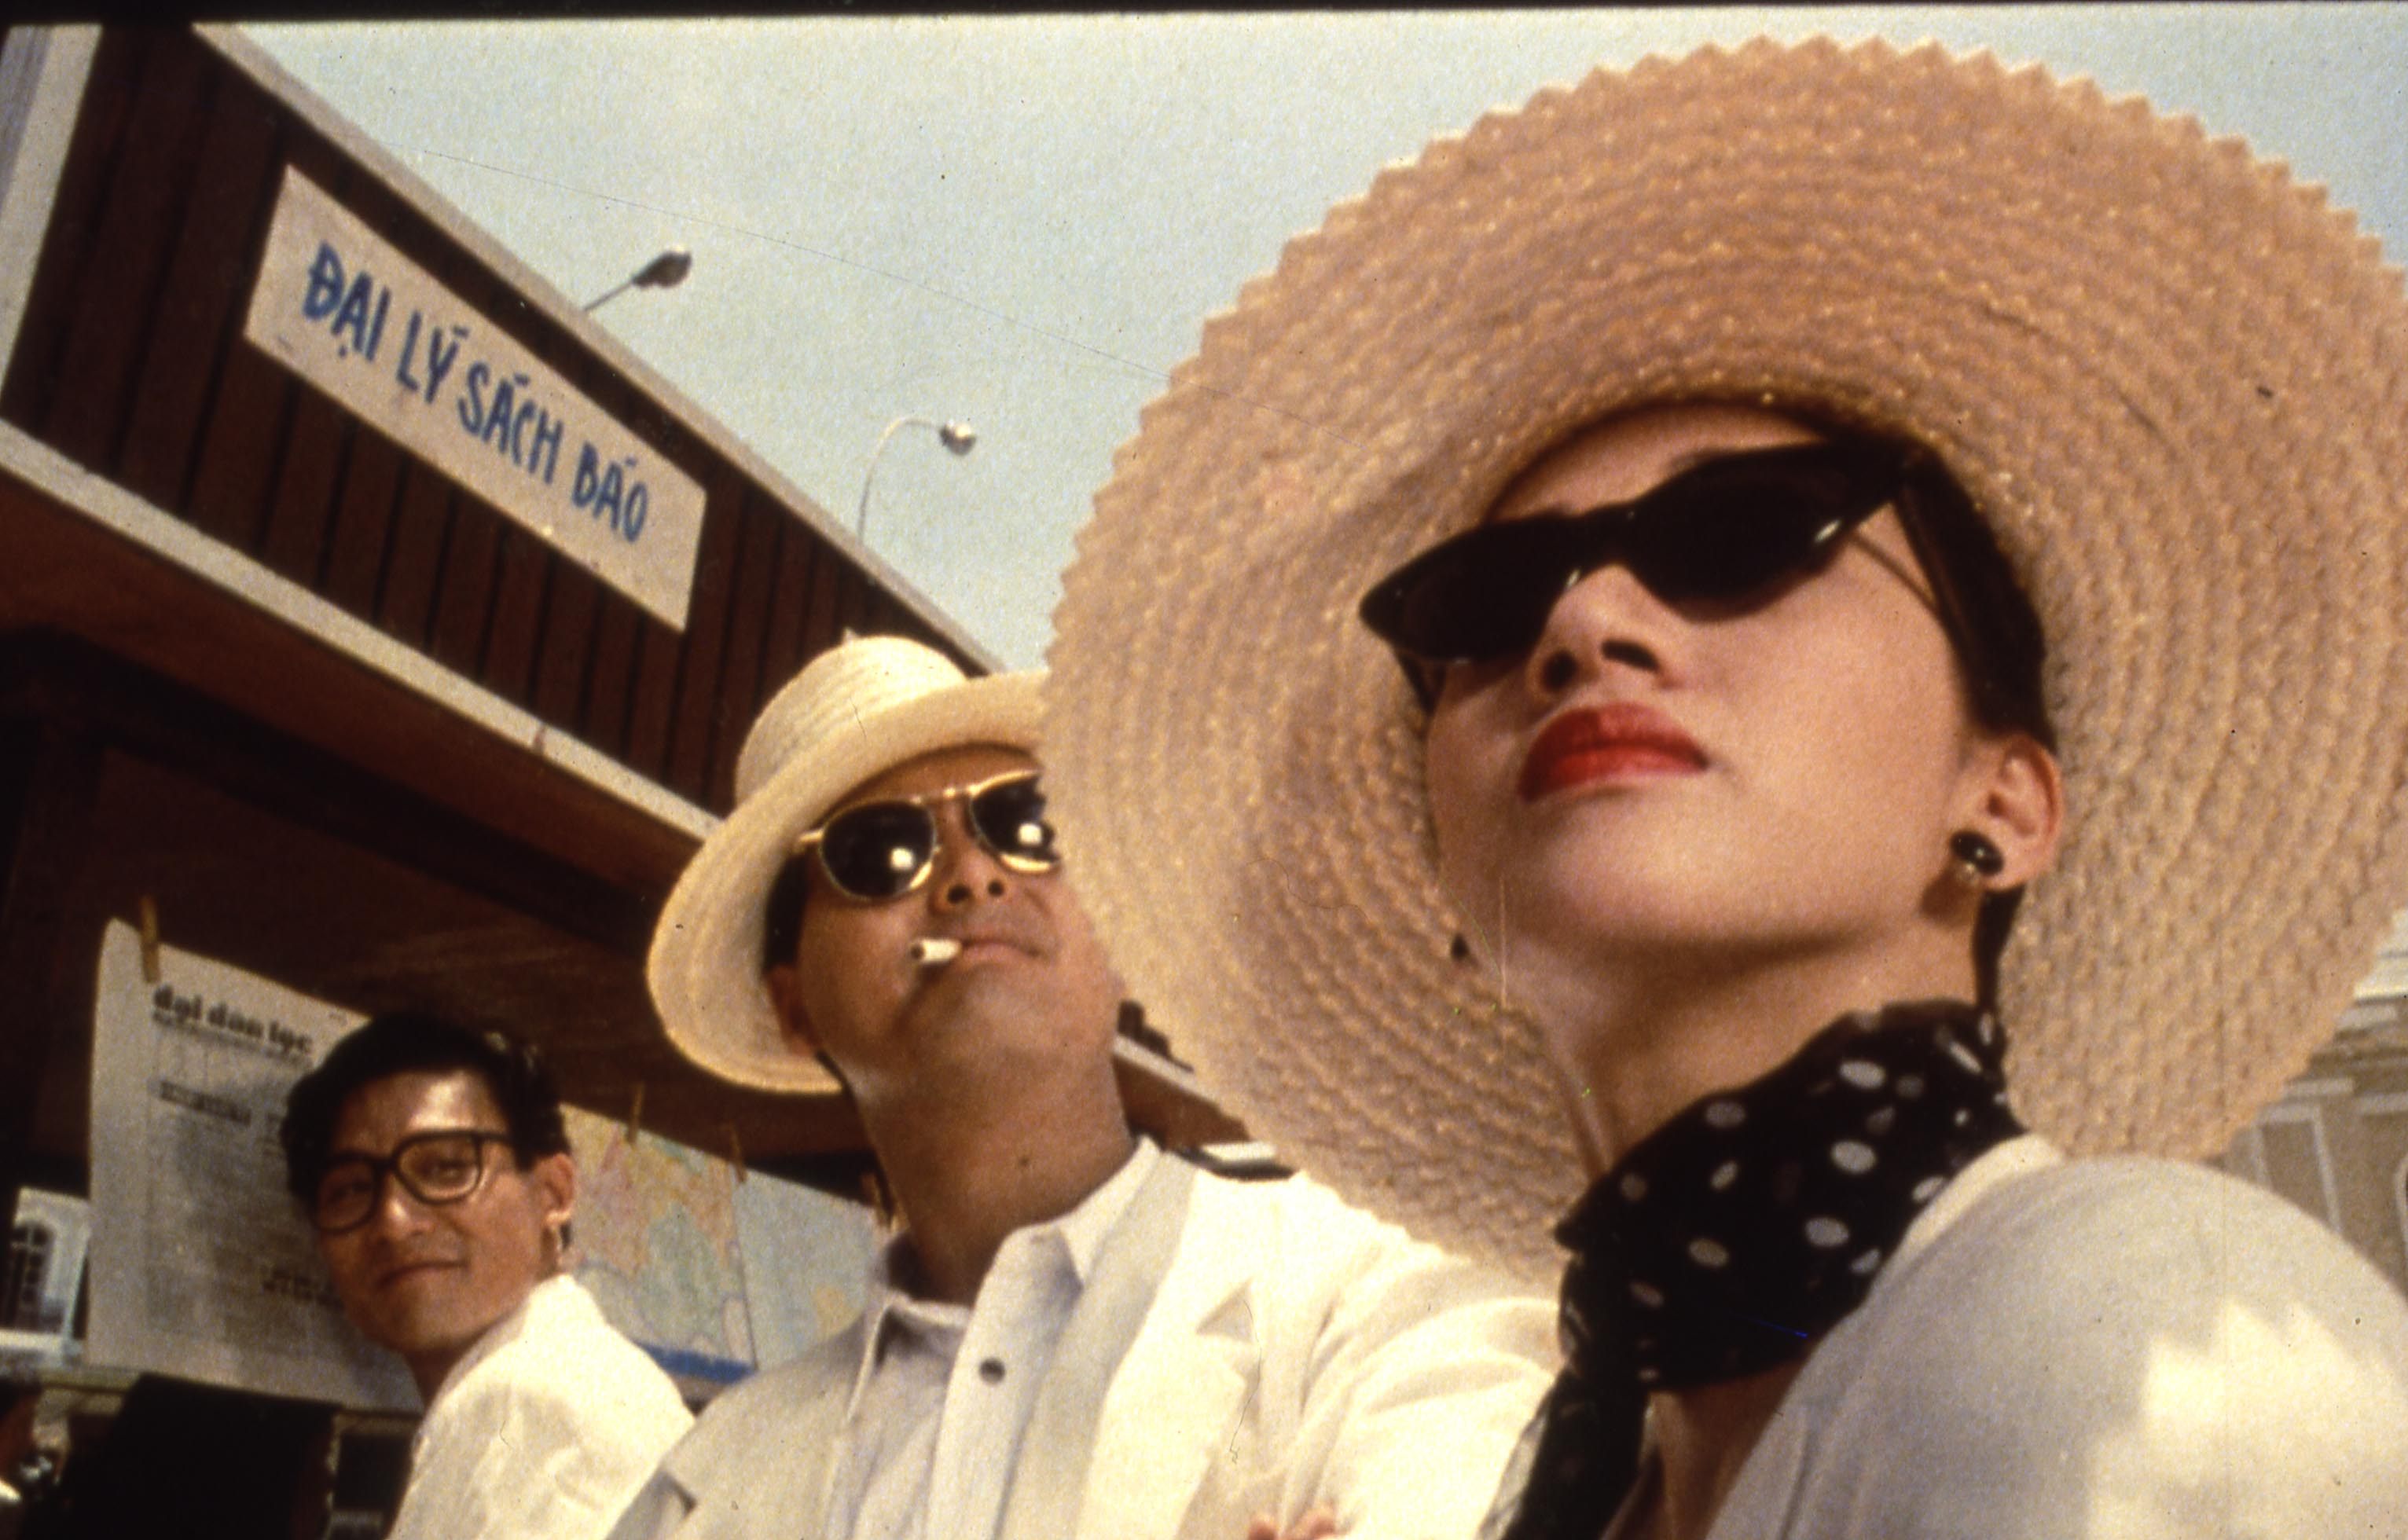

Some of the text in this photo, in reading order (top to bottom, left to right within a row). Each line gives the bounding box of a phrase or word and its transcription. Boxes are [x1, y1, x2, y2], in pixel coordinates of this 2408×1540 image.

[304, 241, 648, 543] ĐẠI LÝ SÁCH BÁO
